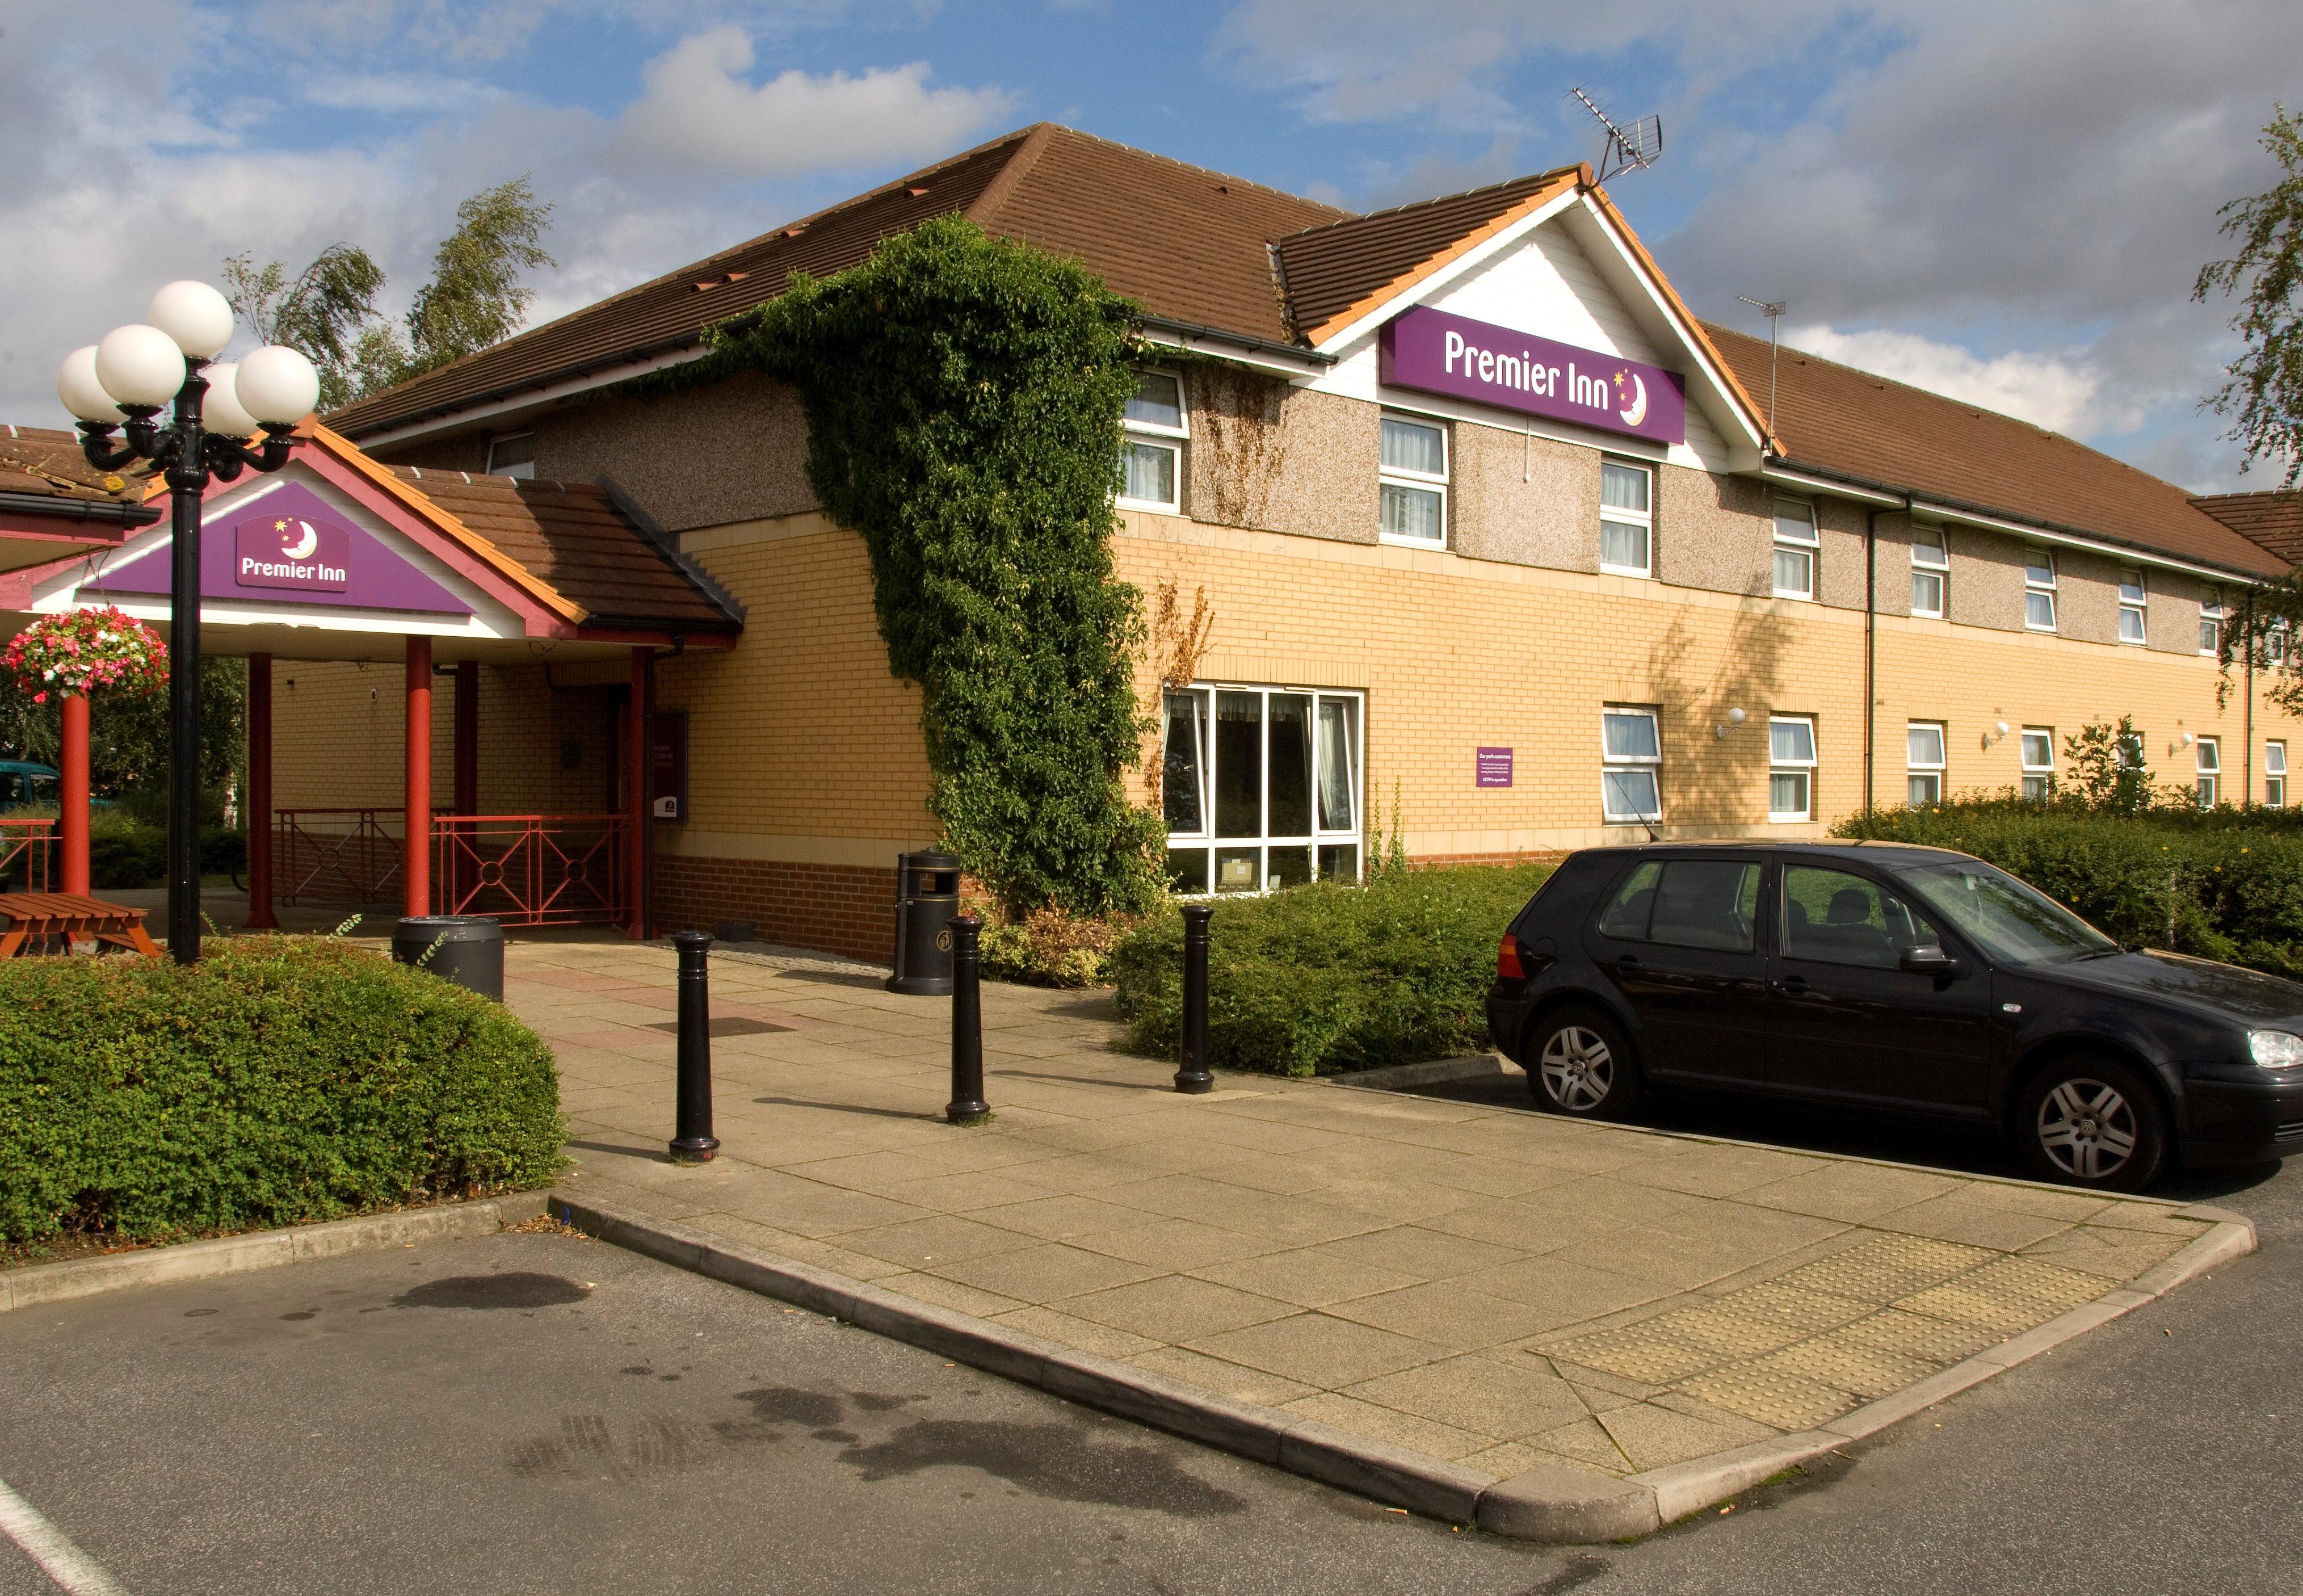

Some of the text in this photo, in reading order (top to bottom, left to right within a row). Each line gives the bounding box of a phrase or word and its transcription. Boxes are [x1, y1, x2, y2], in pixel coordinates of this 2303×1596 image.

[1445, 331, 1608, 410] Premier Inn
[242, 557, 346, 582] Premier Inn
